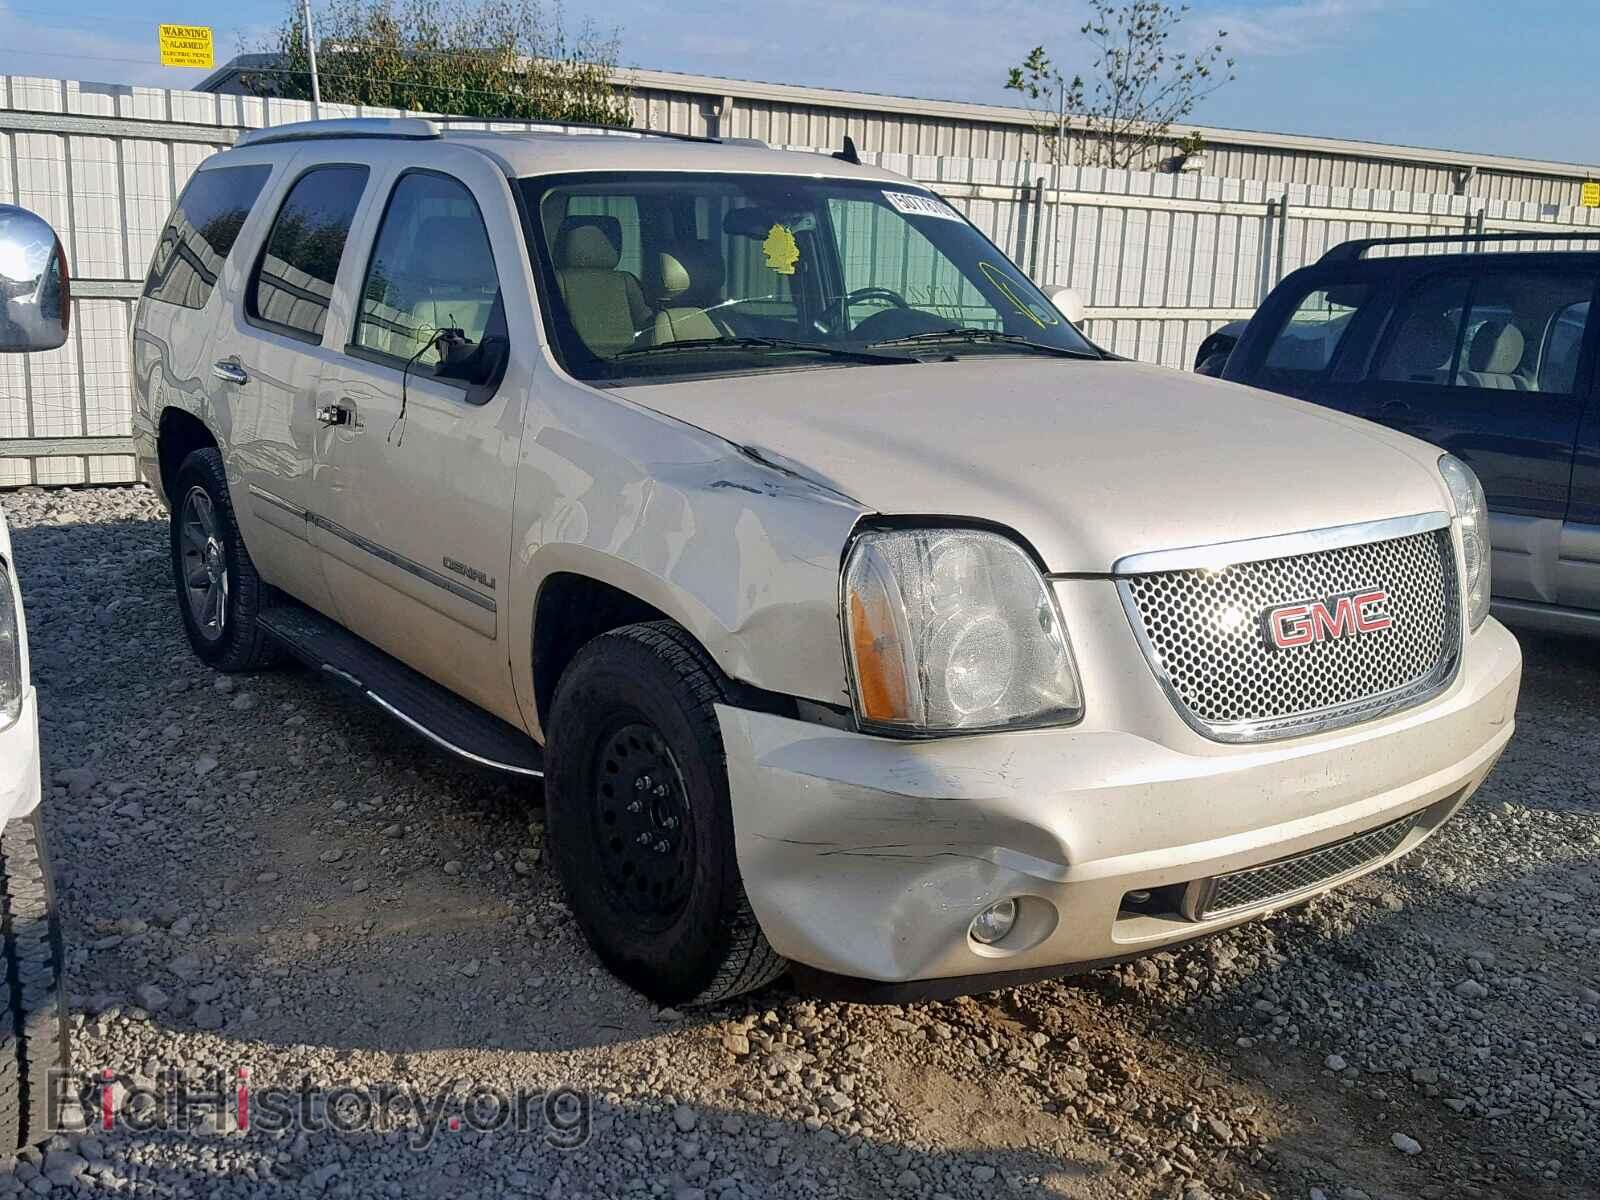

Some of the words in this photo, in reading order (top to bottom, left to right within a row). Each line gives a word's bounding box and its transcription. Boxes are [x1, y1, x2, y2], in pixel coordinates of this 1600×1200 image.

[162, 26, 209, 38] WARNING
[170, 40, 204, 50] ALARMED
[443, 556, 496, 591] DENALI
[1271, 591, 1392, 648] GMC
